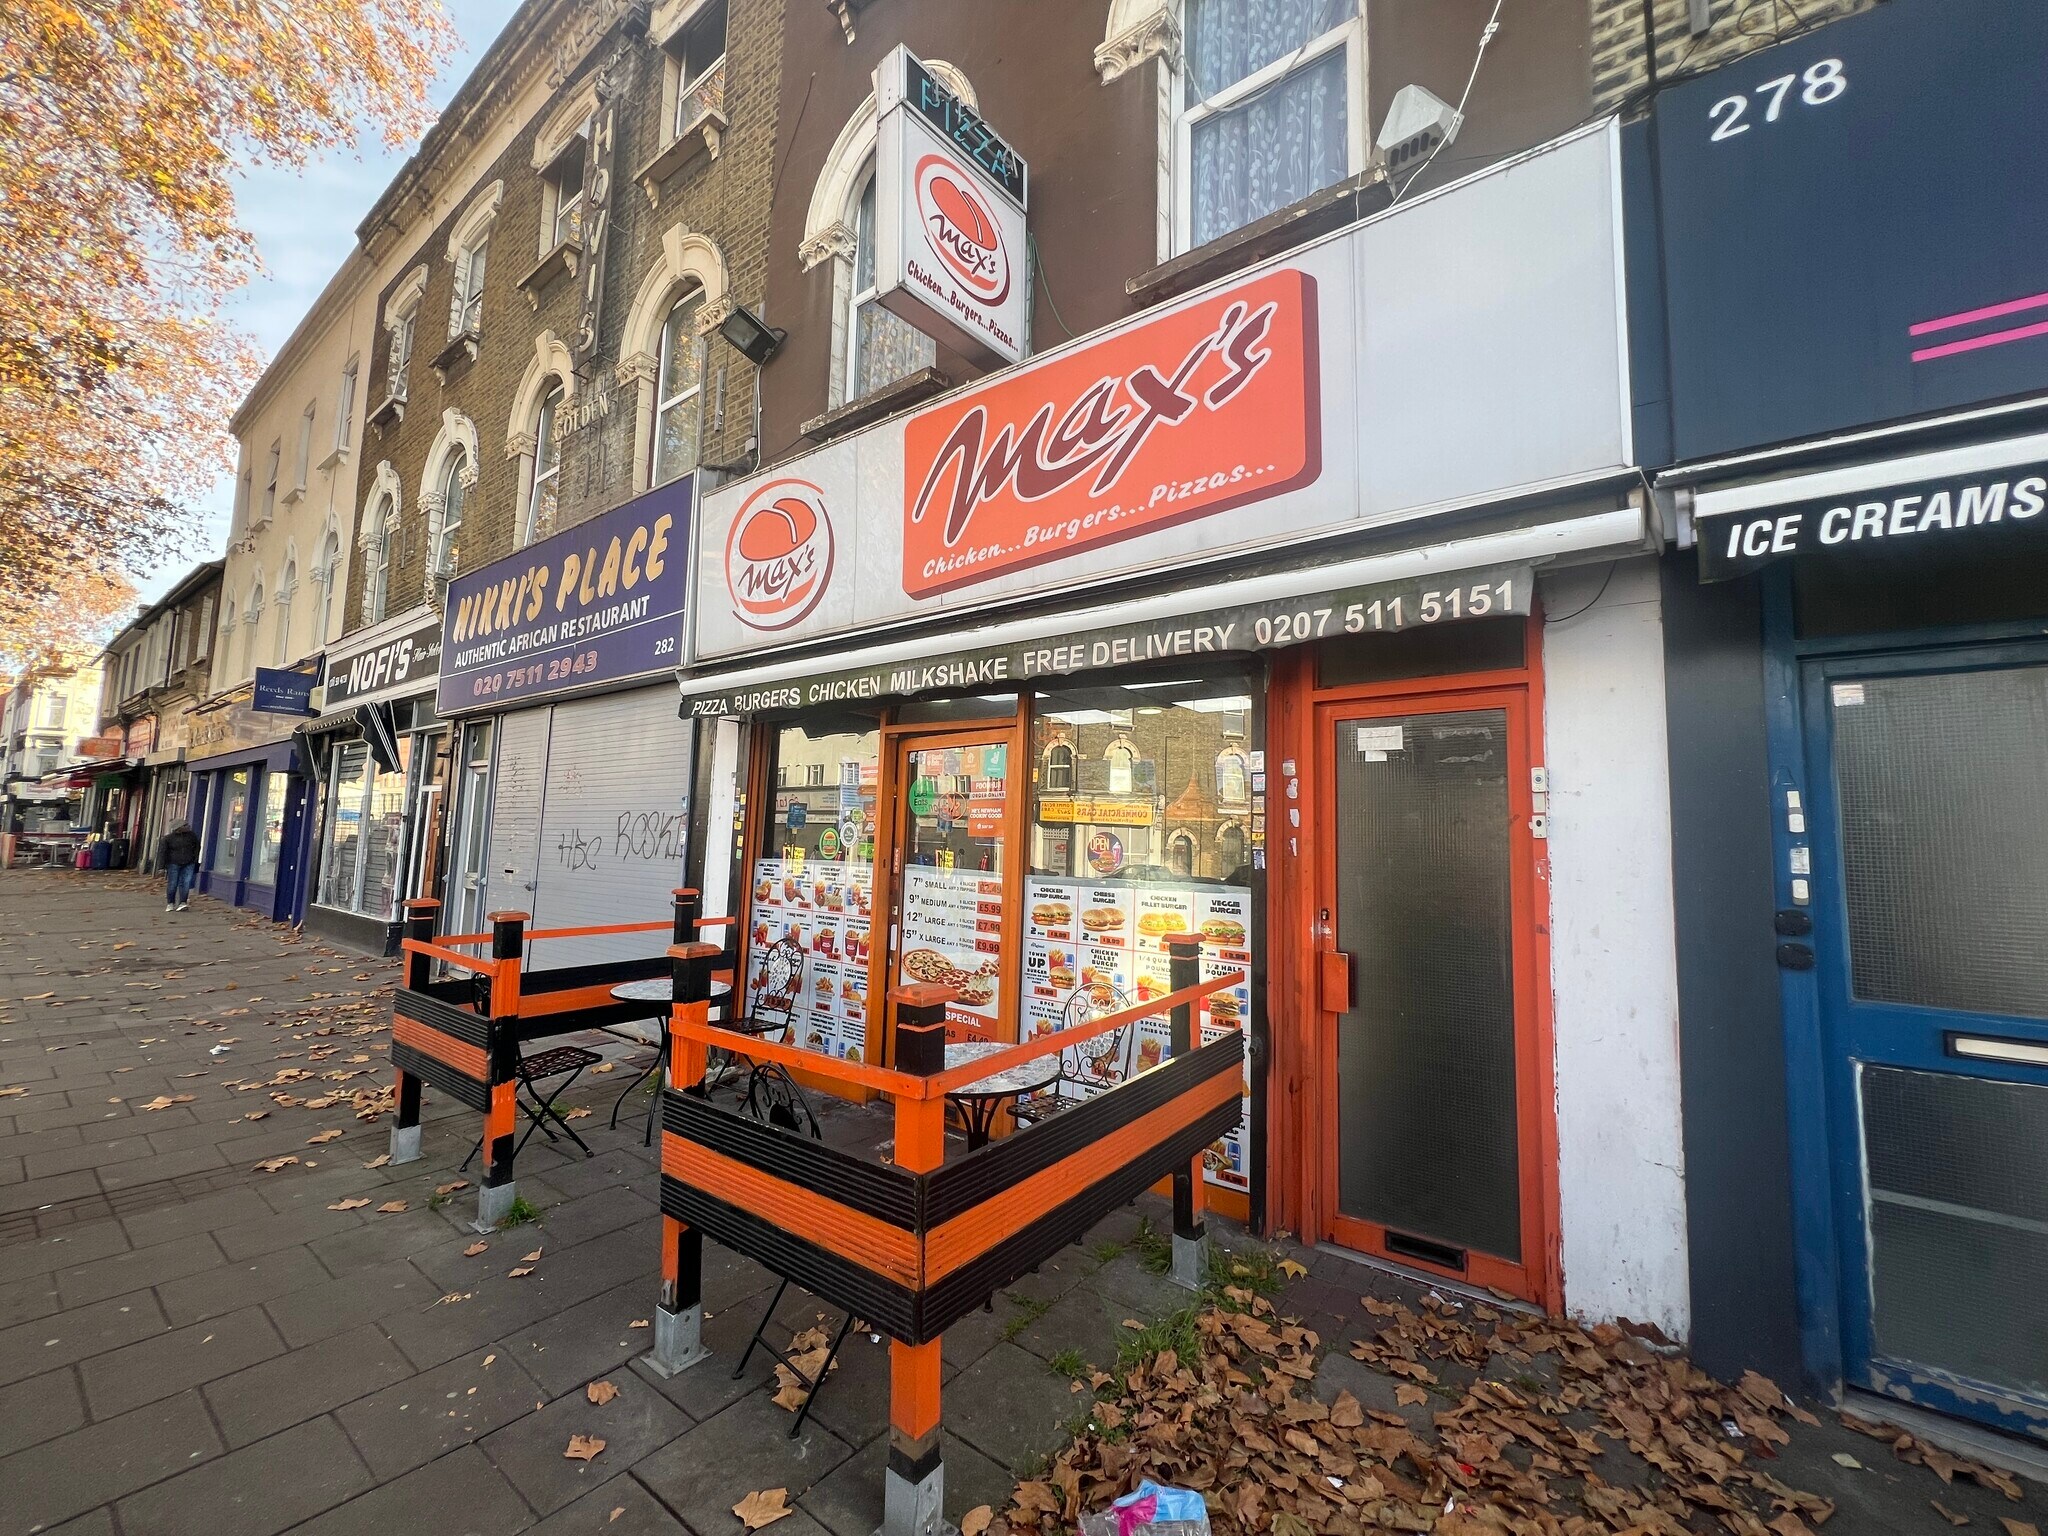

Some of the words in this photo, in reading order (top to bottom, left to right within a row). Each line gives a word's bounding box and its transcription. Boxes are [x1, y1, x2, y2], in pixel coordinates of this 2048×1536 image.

[1708, 57, 1848, 142] 278
[920, 68, 1019, 187] PIZZA
[929, 214, 996, 276] Max's
[911, 300, 1279, 548] Max's
[1725, 514, 1802, 559] ICE
[1818, 477, 2047, 546] CREAMS
[452, 565, 549, 644] NIKKI'S
[555, 513, 673, 613] PLACE
[737, 543, 815, 599] Max's
[454, 639, 507, 669] AUTHENTIC
[508, 624, 559, 655] AFRICAN
[560, 594, 651, 640] RESTAURANT
[653, 636, 675, 656] 282
[691, 696, 728, 716] PIZZA
[734, 687, 801, 712] BURGERS
[808, 675, 881, 704] CHICKEN
[890, 656, 1008, 693] MILKSHAKE
[1022, 643, 1086, 676] FREE
[1092, 623, 1236, 667] DELIVERY
[1253, 607, 1333, 645] 0207
[1343, 596, 1405, 634] 511
[1419, 579, 1514, 623] 5151
[346, 637, 413, 695] NOFI'S
[473, 673, 503, 697] 020
[505, 665, 543, 690] 7511
[547, 650, 598, 681] 2943
[1090, 834, 1110, 852] OPEN
[924, 880, 947, 890] SMALL
[920, 897, 947, 908] MEDIUM
[979, 903, 1001, 915] £5.99
[1209, 906, 1242, 915] BURGER
[1211, 899, 1241, 908] VEGGIE
[924, 916, 946, 926] LARGE
[977, 921, 1001, 933] £7.99
[925, 935, 946, 945] LARGE
[977, 942, 1000, 953] £9.99
[1090, 948, 1119, 957] CHICKEN
[1026, 967, 1048, 975] BURGER
[1028, 957, 1046, 969] UP
[1091, 959, 1118, 968] BURGER
[945, 1011, 981, 1028] SPECIAL
